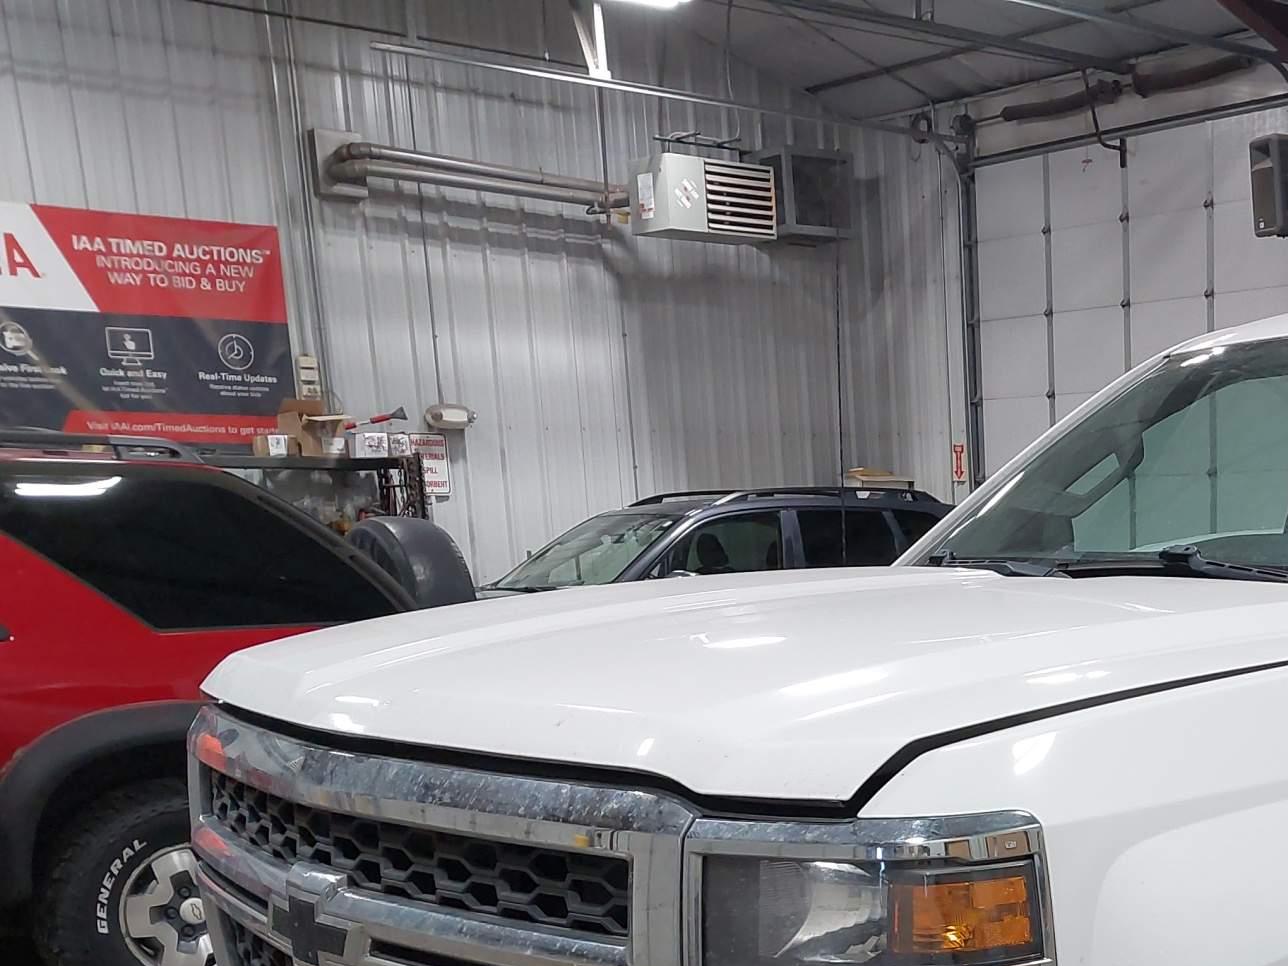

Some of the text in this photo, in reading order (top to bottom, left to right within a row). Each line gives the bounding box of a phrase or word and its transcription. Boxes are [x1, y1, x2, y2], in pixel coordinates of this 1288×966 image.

[0, 232, 41, 278] A
[71, 235, 106, 252] IAA
[107, 238, 167, 257] TIMED
[96, 254, 255, 278] INTRODUCING A NEW
[107, 271, 246, 293] WAY TO BID & BUY
[145, 369, 167, 379] Easy
[198, 371, 278, 384] Real-Time Updates
[227, 425, 238, 434] to
[96, 839, 148, 934] GENERAL
